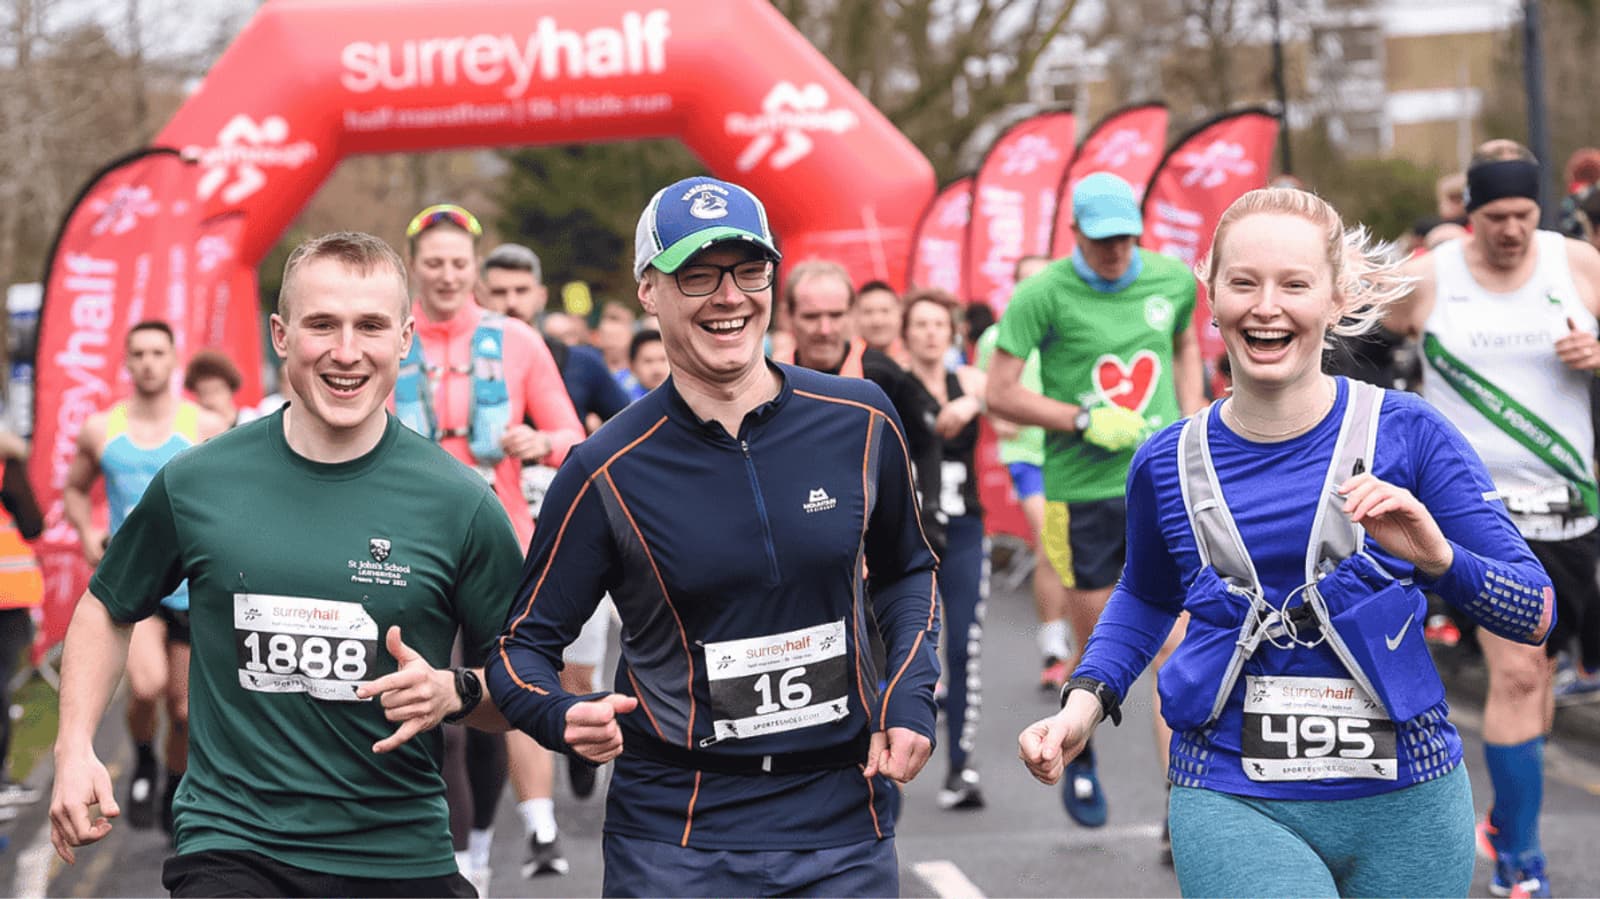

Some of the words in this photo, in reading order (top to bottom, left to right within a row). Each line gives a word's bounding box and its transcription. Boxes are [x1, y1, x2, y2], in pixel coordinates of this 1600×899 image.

[341, 9, 671, 98] surreyhalf
[384, 563, 411, 573] School
[272, 606, 340, 622] surreyhalf
[244, 632, 367, 680] 1888
[746, 635, 812, 660] surreyhalf
[754, 667, 812, 714] 16
[1282, 685, 1355, 700] surreyhalf
[1261, 715, 1375, 758] 495
